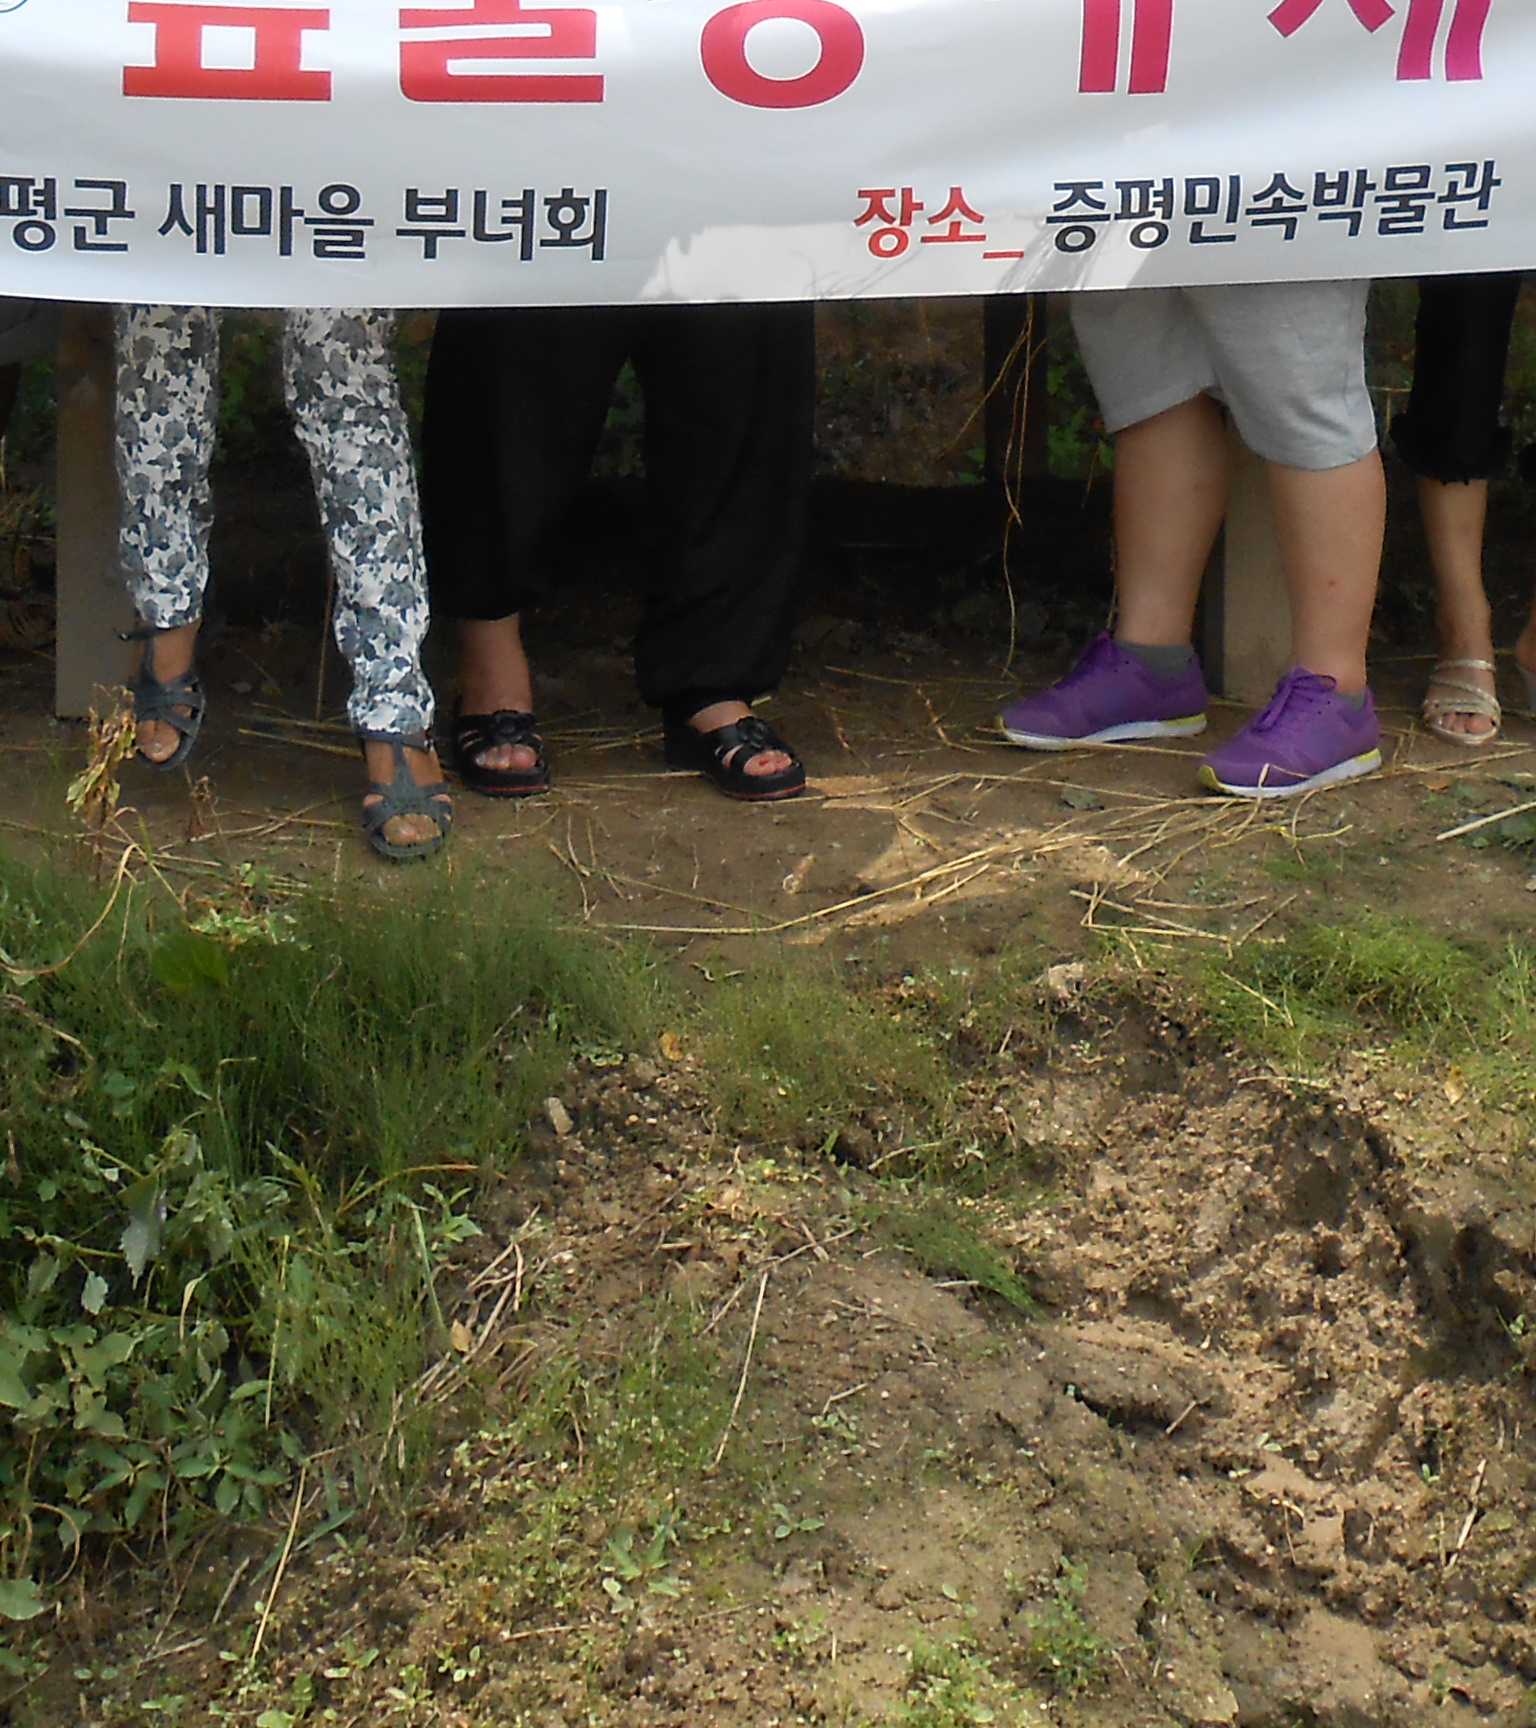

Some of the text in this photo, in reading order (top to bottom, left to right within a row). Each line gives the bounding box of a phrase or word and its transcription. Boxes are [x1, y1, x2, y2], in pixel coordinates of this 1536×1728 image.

[157, 183, 374, 259] 새마을
[395, 188, 607, 261] 부녀회
[1046, 160, 1502, 253] 증평민속박물관
